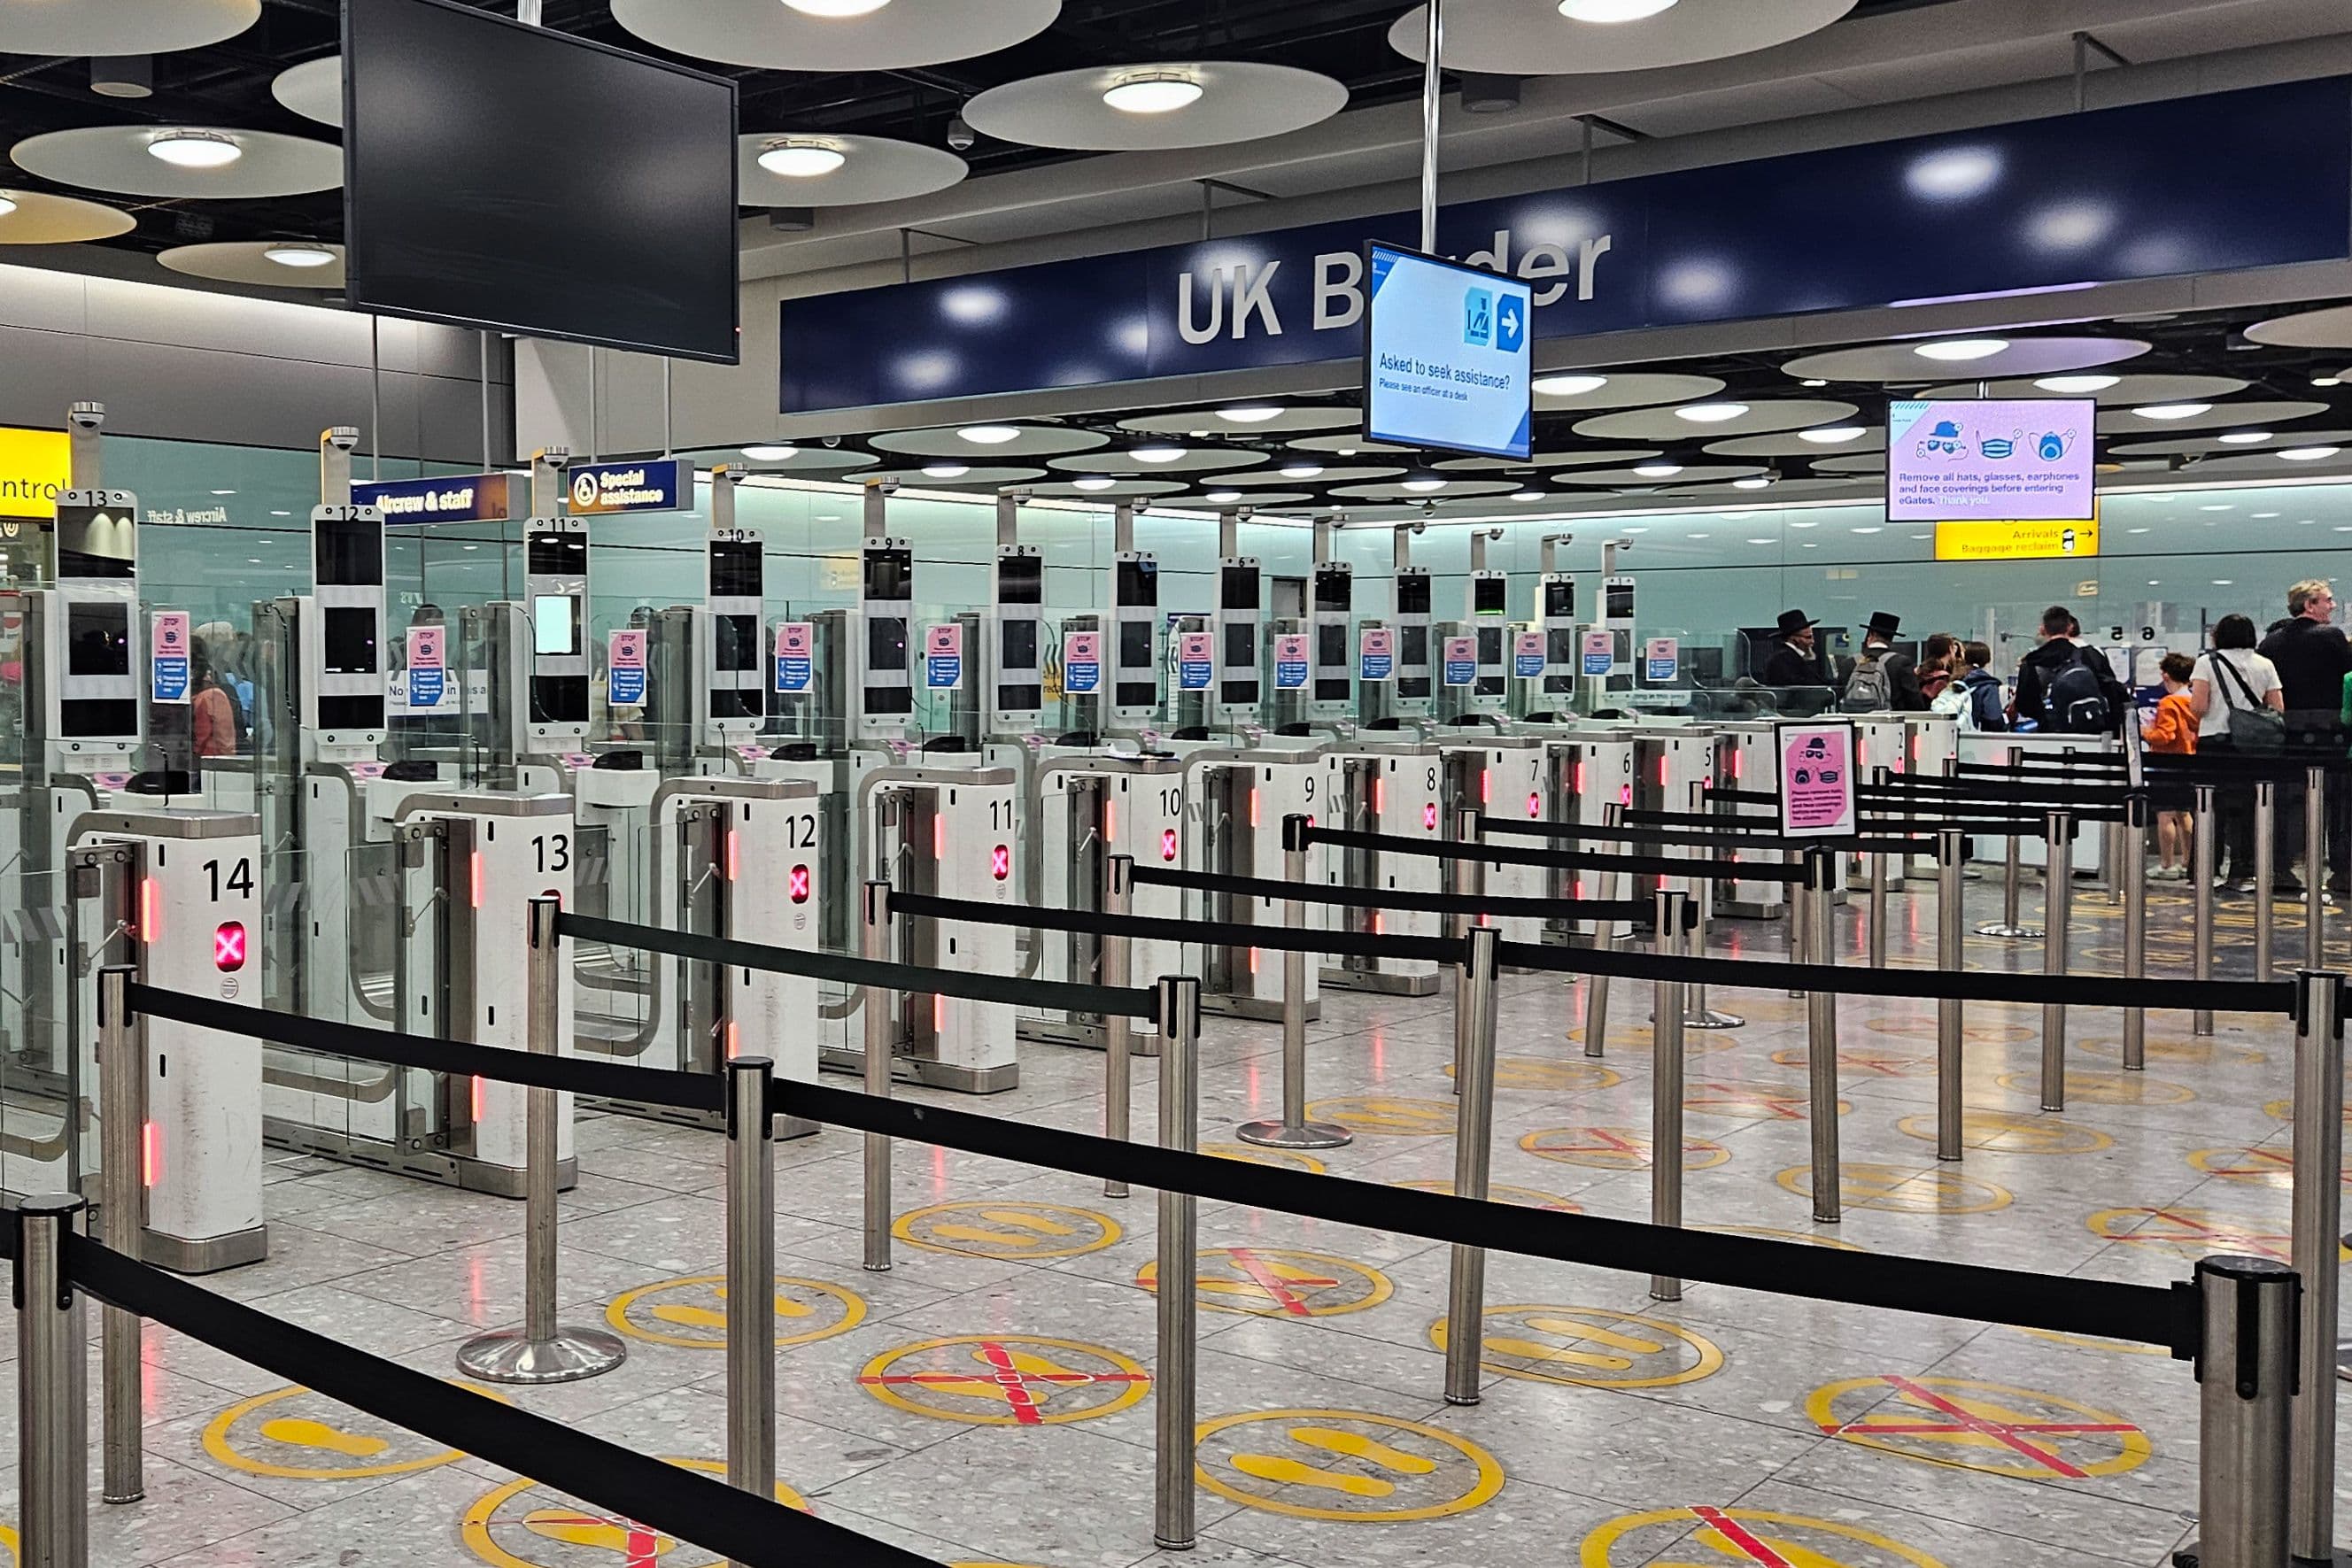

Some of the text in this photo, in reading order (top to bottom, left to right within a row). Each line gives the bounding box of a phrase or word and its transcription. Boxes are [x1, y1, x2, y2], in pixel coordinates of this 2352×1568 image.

[1179, 230, 1611, 345] UK Bder
[1380, 352, 1511, 390] Asked to seek assistance?
[1379, 378, 1400, 391] Please
[1401, 382, 1413, 392] see
[1413, 384, 1421, 394] an
[1443, 388, 1449, 398] at
[1454, 390, 1468, 401] desk
[600, 469, 645, 490] Special
[1899, 472, 2079, 483] Remove all hats, glasses, earphones
[85, 490, 107, 507] 13
[600, 489, 664, 506] assistance
[1899, 483, 2064, 495] and face coverings before entering
[375, 488, 474, 514] Aircrew & staff
[1899, 496, 1935, 505] eGates.
[339, 506, 359, 521] 12
[550, 518, 565, 532] 11
[2012, 529, 2059, 539] Arrivals
[1961, 543, 2059, 553] Baggage reclaim
[1623, 753, 1630, 774] 6
[1705, 746, 1711, 767] 5
[1427, 767, 1435, 791] 8
[1531, 759, 1538, 781] 7
[1305, 776, 1314, 802] 9
[1160, 788, 1180, 816] 10
[990, 799, 1011, 830] 11
[785, 815, 816, 848] 12
[531, 834, 569, 873] 13
[203, 858, 254, 901] 14
